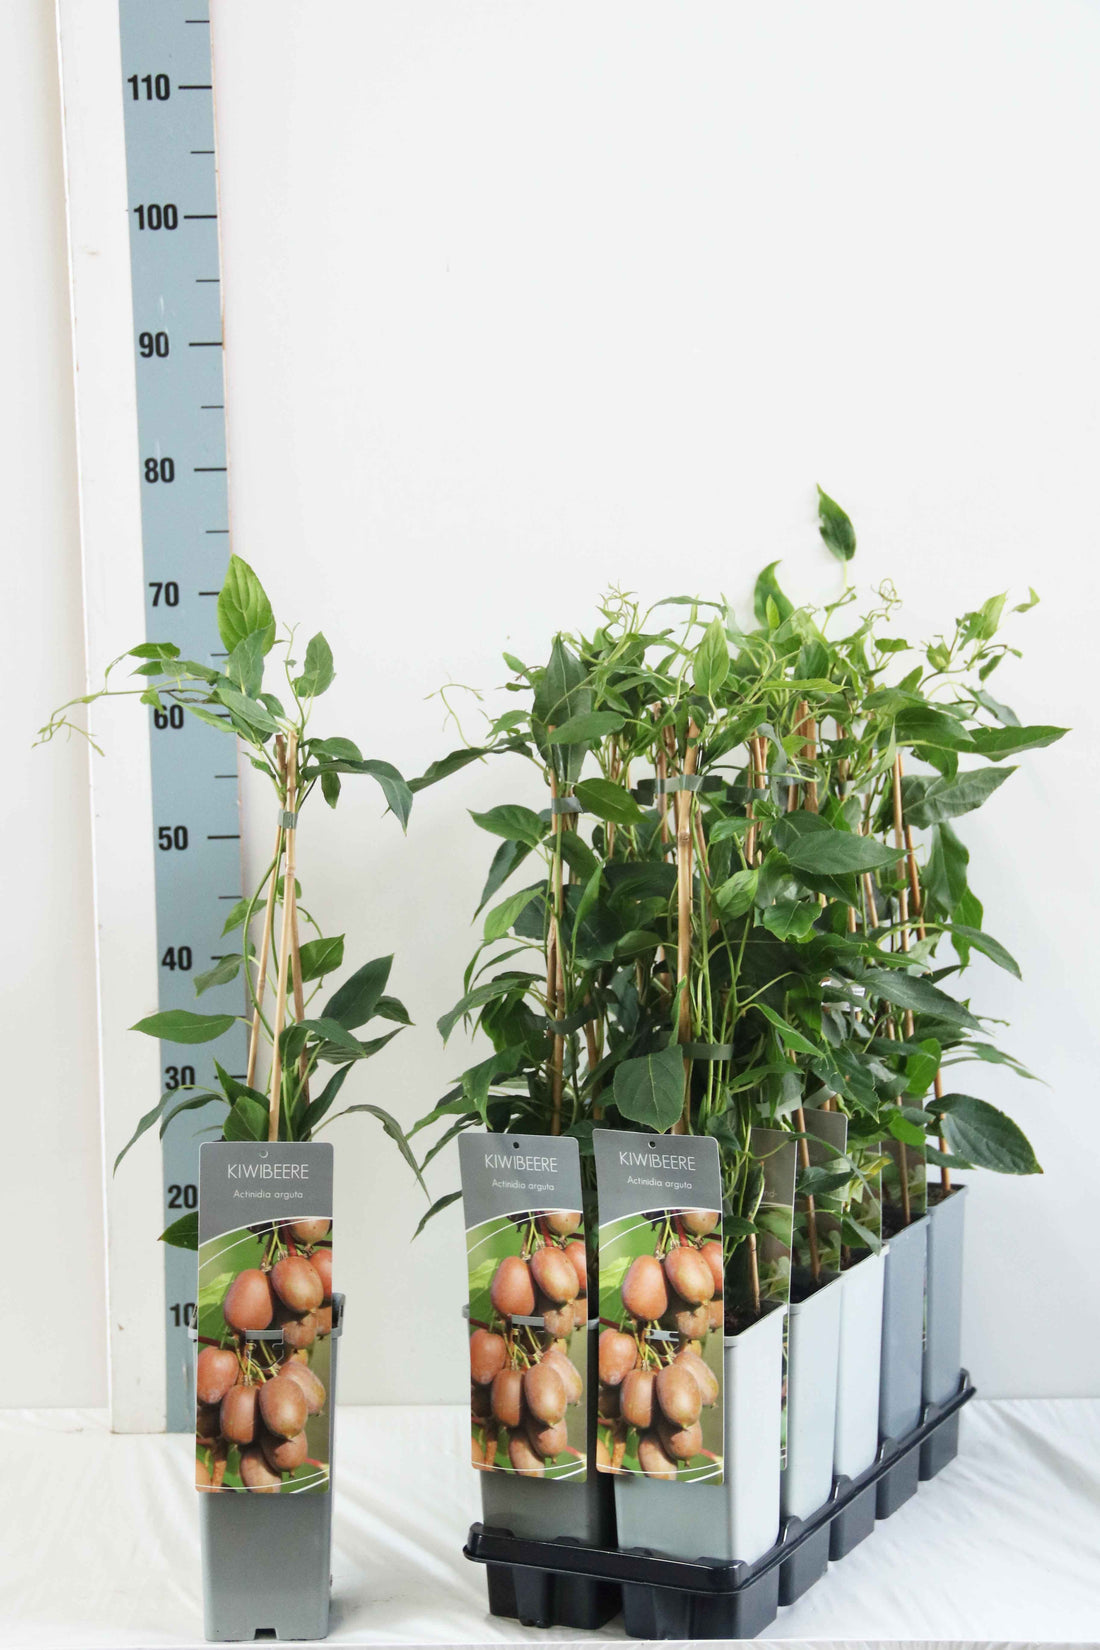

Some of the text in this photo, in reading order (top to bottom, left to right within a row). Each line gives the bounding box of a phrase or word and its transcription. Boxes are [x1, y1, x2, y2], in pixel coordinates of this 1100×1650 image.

[127, 73, 170, 101] 110
[133, 203, 178, 231] 100
[139, 331, 169, 358] 90
[144, 457, 174, 484] 80
[148, 581, 179, 607] 70
[154, 704, 184, 730] 60
[158, 825, 189, 851] 50
[161, 945, 193, 972] 40
[164, 1065, 196, 1090] 30
[227, 1163, 309, 1180] KIWIBEERE
[484, 1153, 559, 1173] KIWIBEERE
[619, 1151, 697, 1172] KIWIBEERE
[167, 1184, 198, 1209] 20
[232, 1188, 304, 1201] Actinidia arguta
[491, 1178, 555, 1194] Actinidia arguta
[626, 1175, 693, 1193] Actinidia arguta
